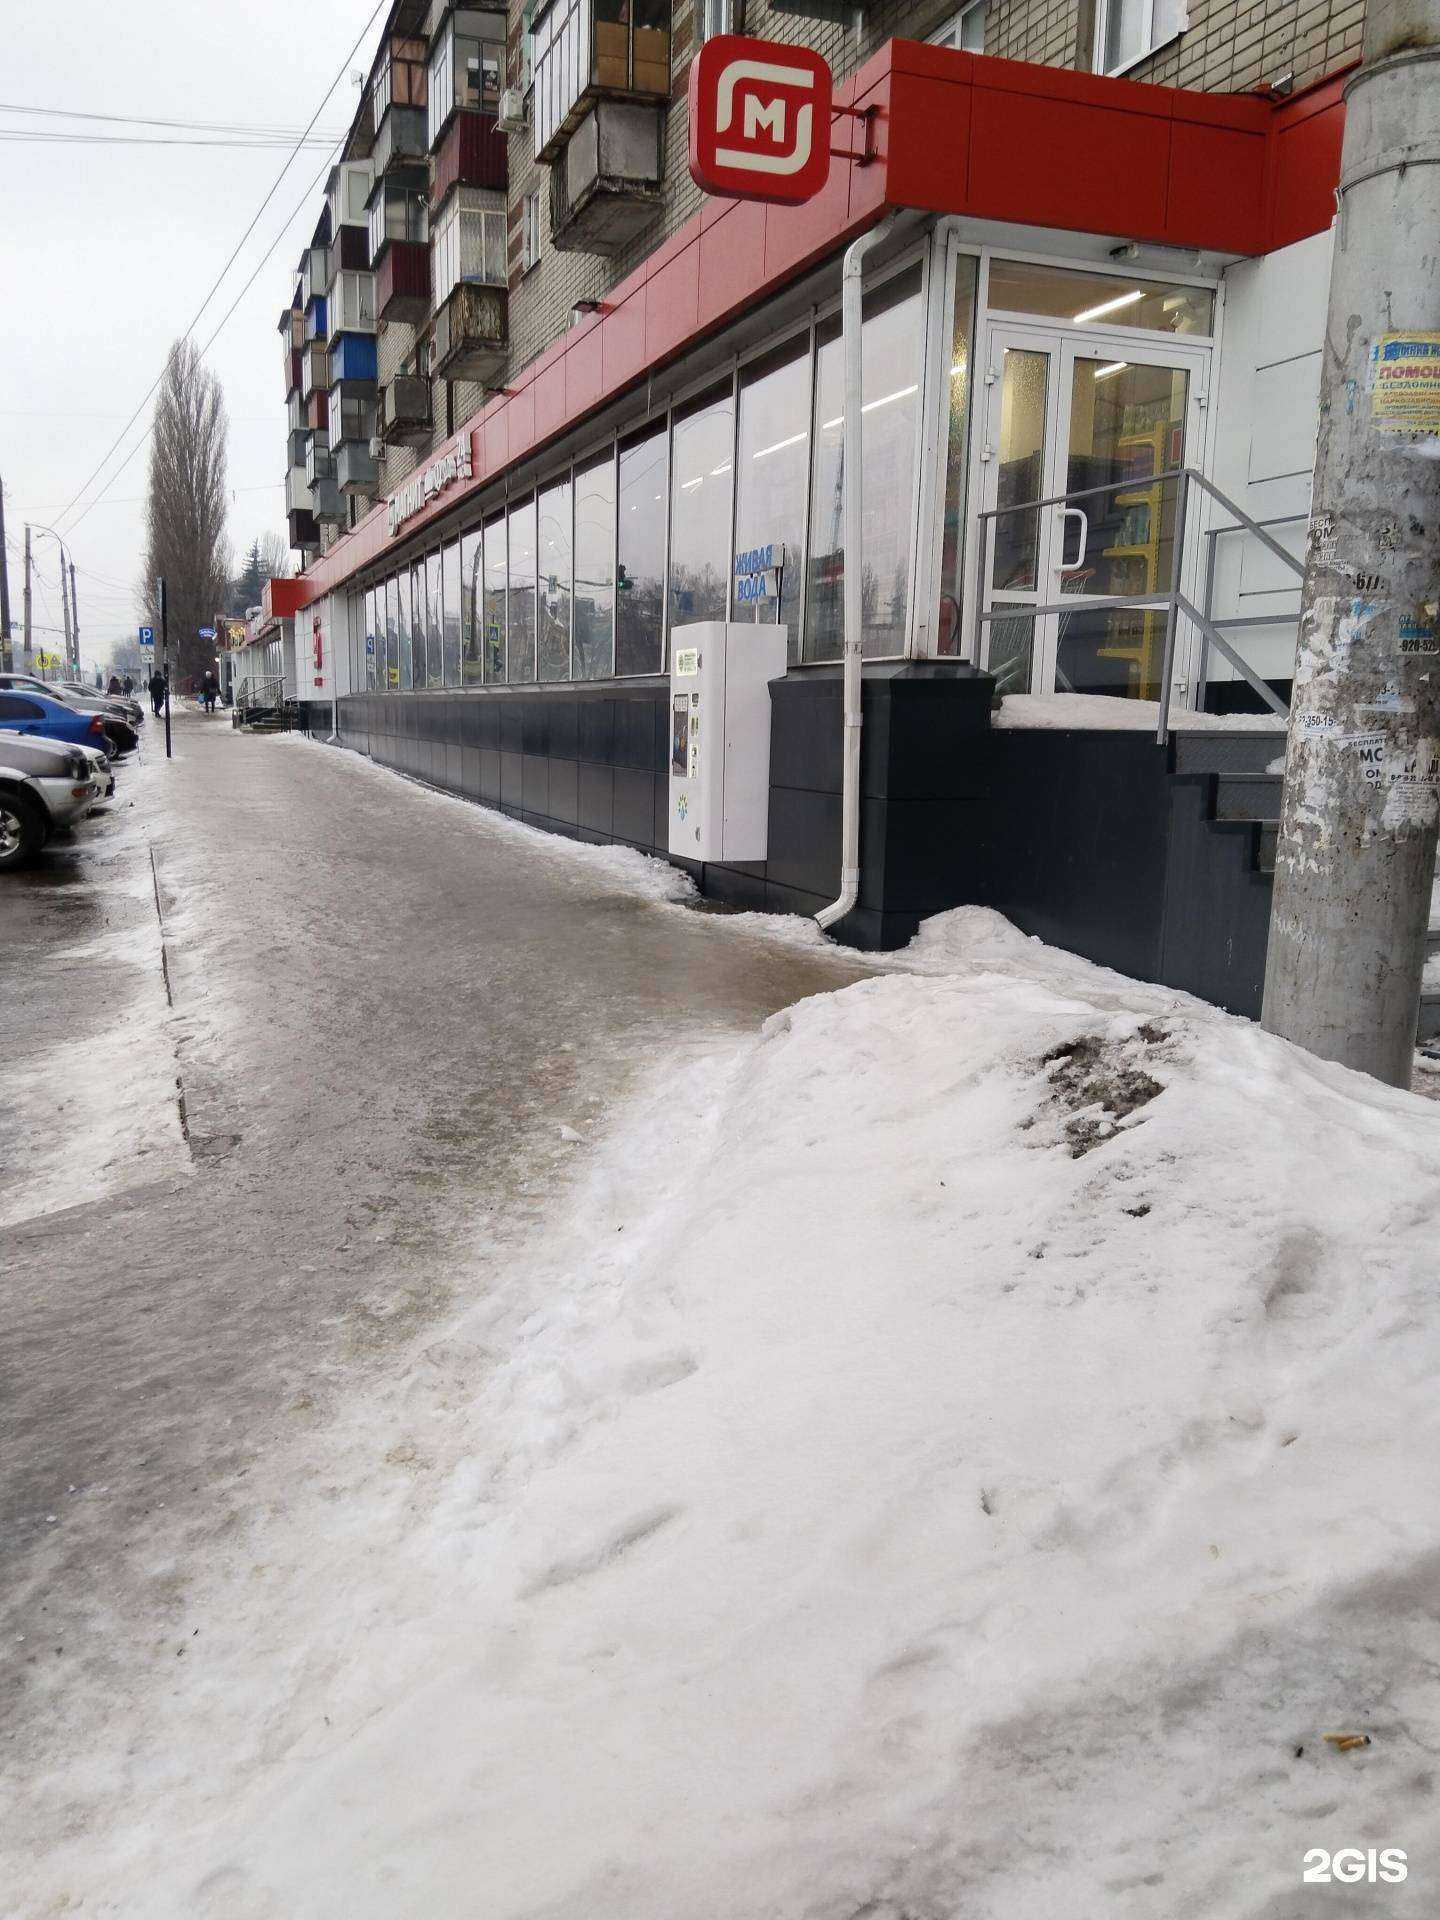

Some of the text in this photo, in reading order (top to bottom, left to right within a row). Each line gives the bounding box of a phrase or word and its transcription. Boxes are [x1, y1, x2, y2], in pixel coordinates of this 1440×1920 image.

[744, 93, 786, 143] М
[736, 544, 773, 575] ЖИВАЯ
[738, 575, 767, 601] ВОДА
[142, 627, 152, 643] P
